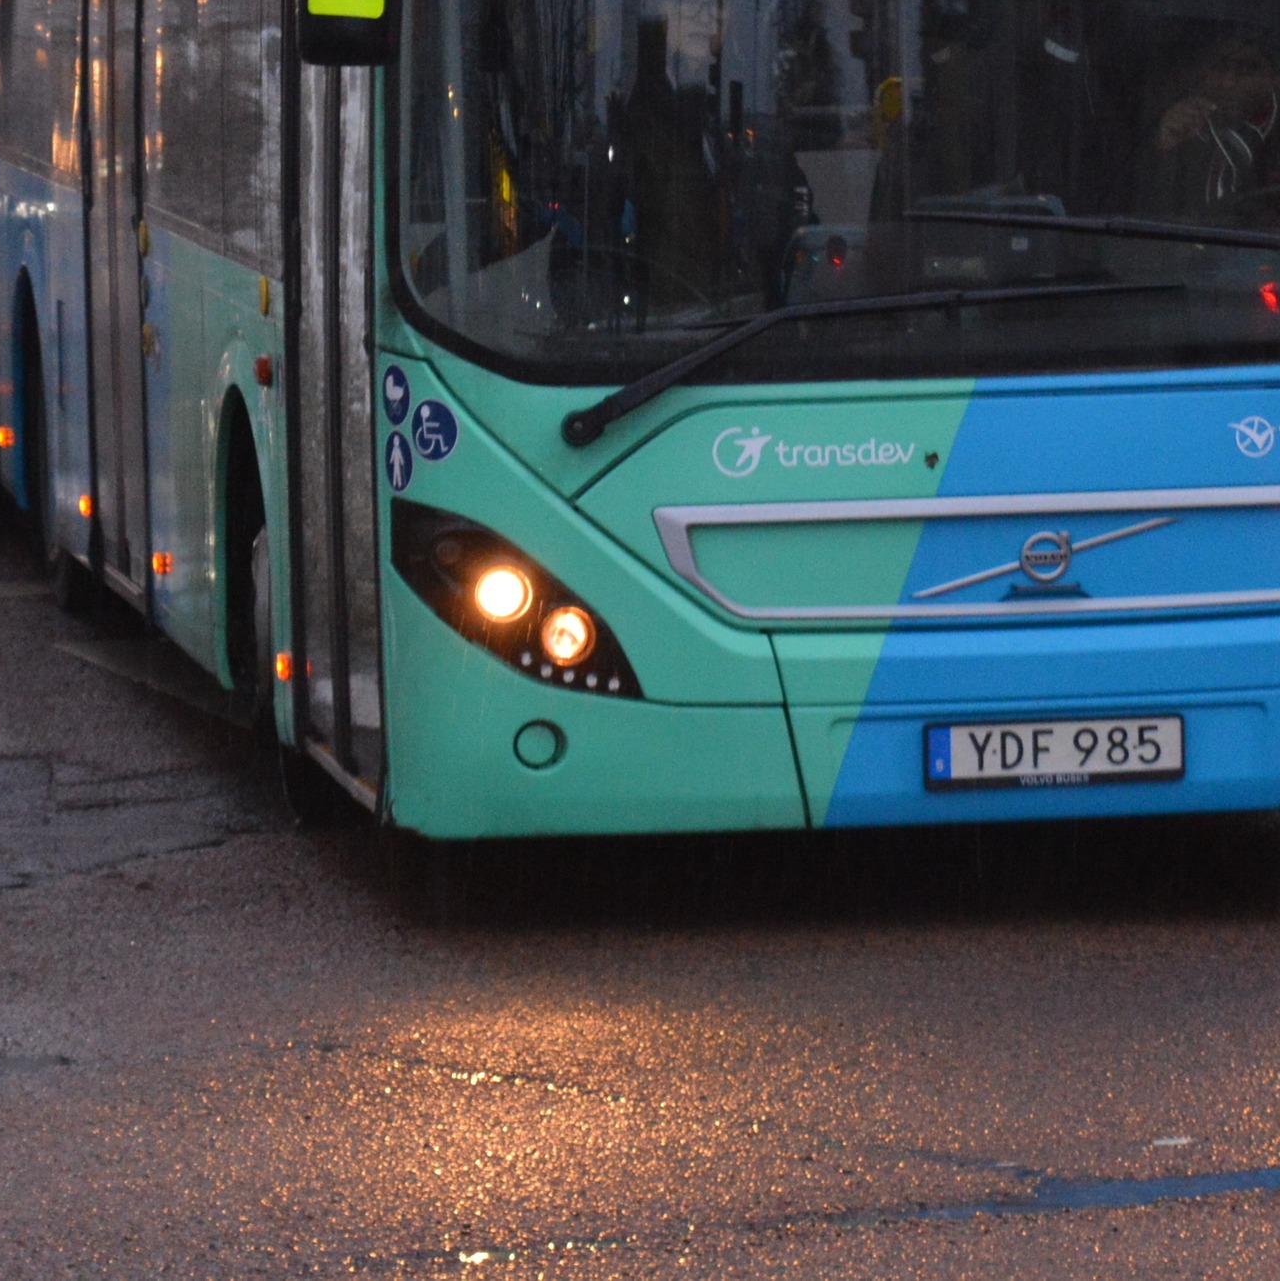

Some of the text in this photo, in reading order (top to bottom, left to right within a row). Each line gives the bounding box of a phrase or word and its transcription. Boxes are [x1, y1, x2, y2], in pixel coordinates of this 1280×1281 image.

[774, 438, 916, 467] transdev
[968, 724, 1162, 771] YDF 985
[1019, 774, 1053, 787] VOLVO
